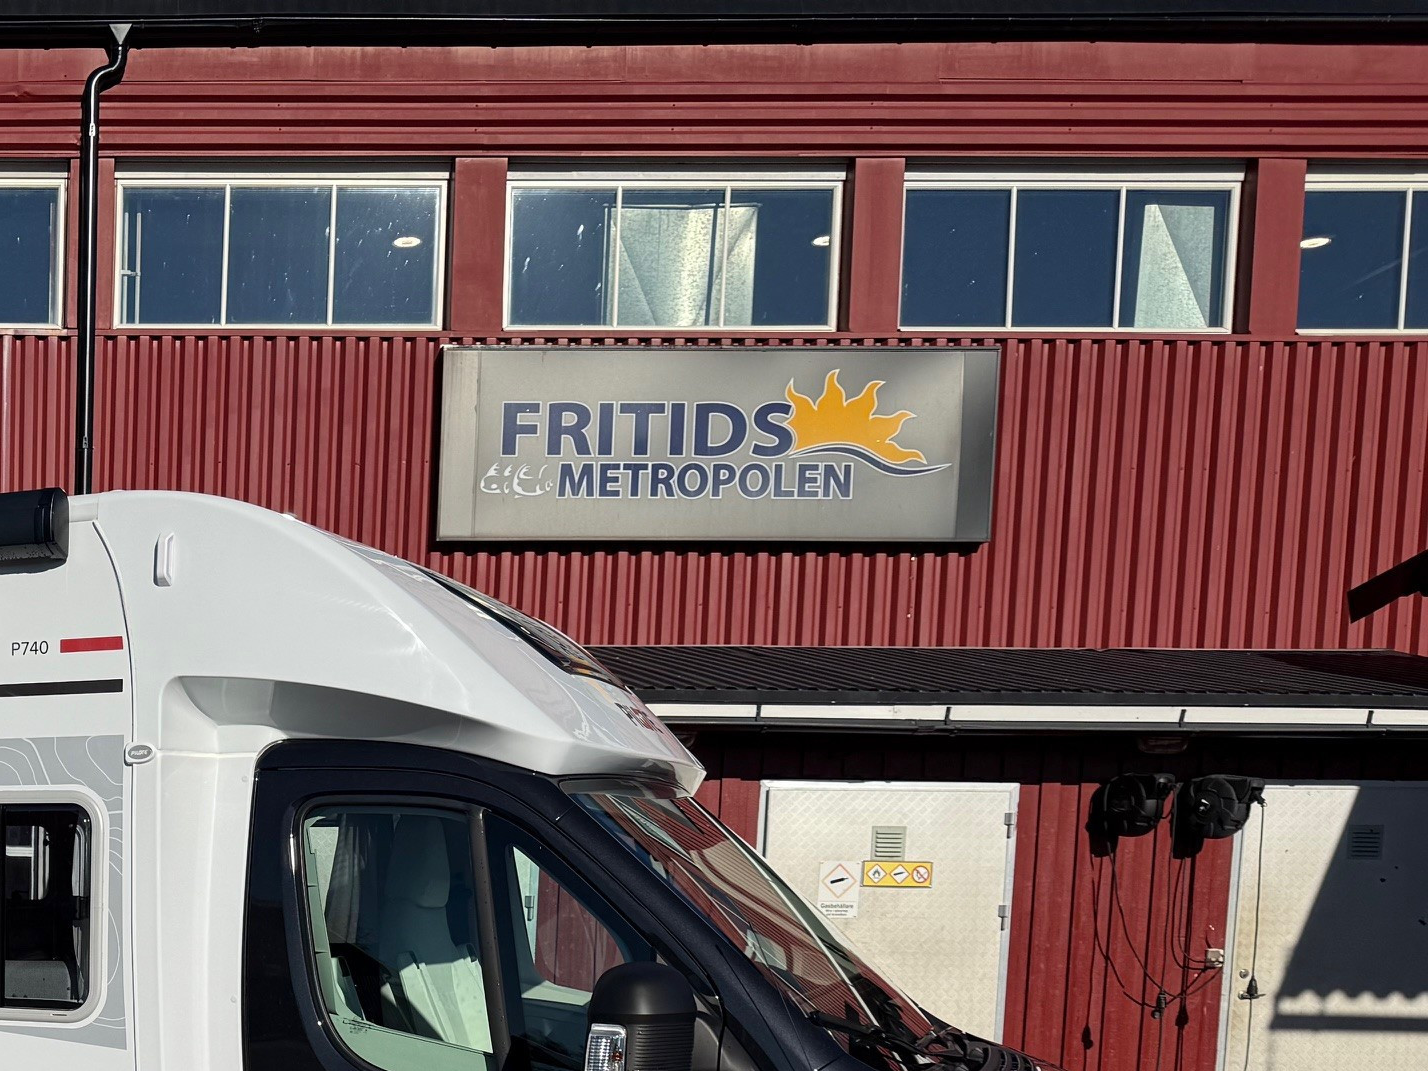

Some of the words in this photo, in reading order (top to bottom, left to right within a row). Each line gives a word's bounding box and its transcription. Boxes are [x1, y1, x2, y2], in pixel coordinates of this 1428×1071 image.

[500, 401, 796, 458] FRITIDS
[556, 462, 854, 499] METROPOLEN
[11, 640, 49, 656] P740
